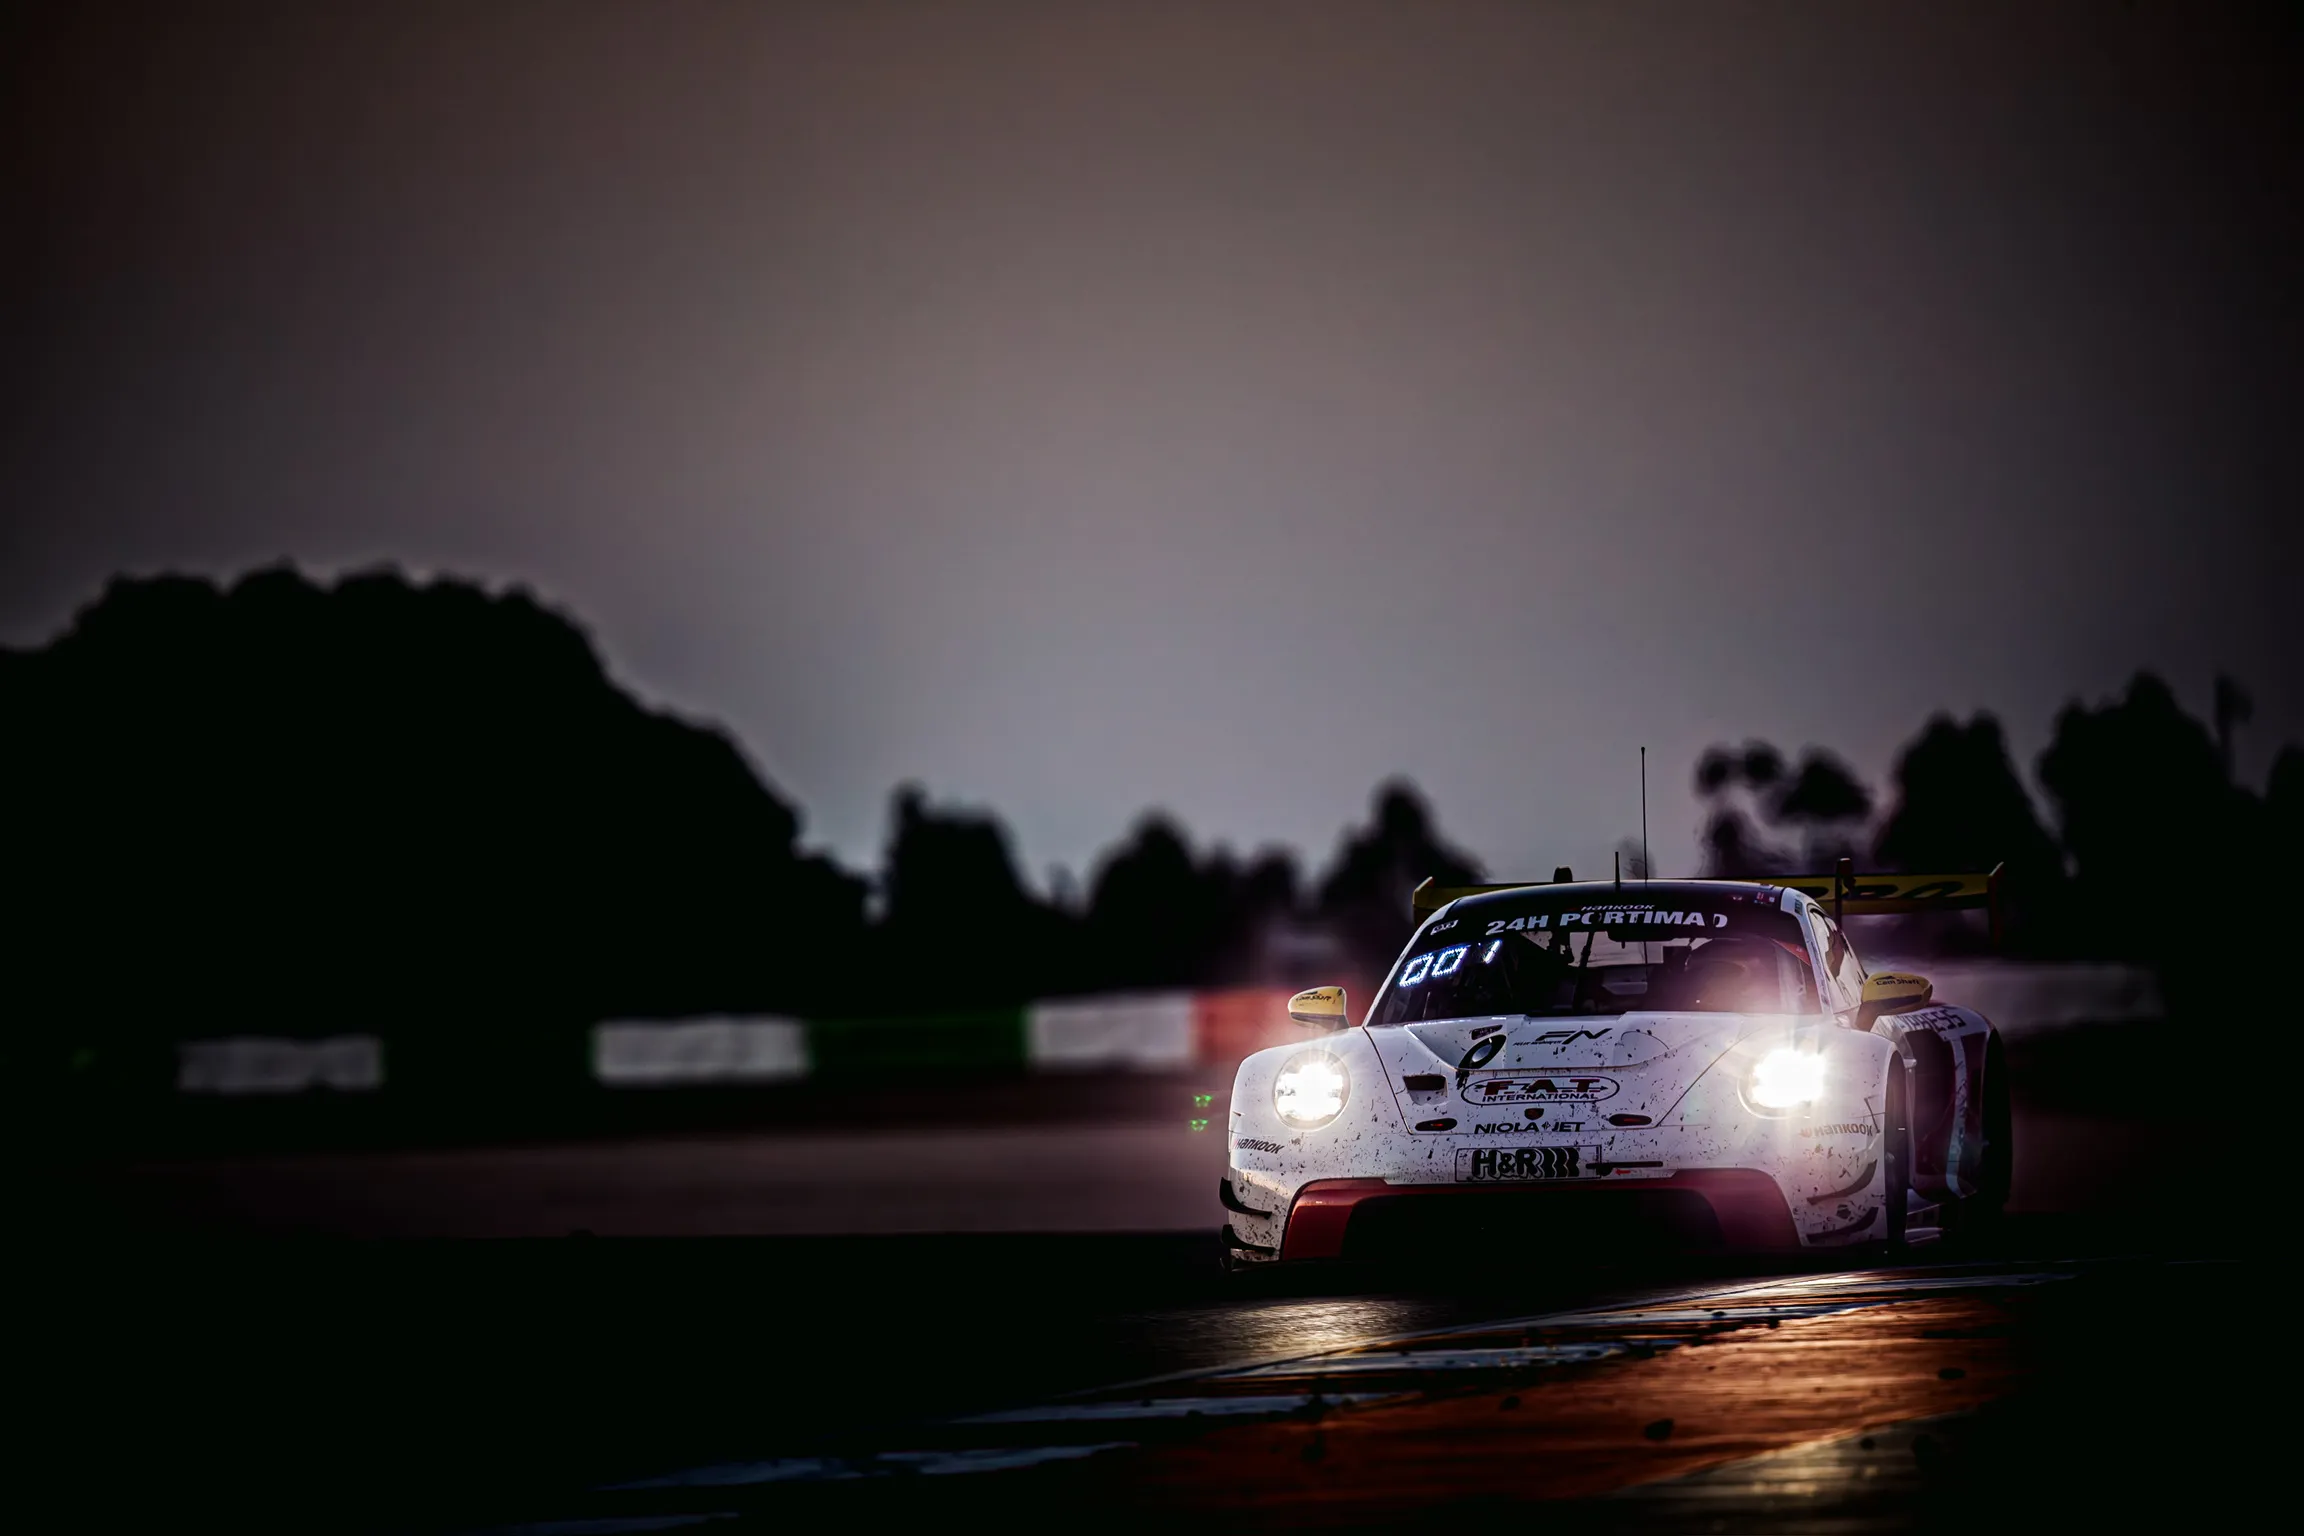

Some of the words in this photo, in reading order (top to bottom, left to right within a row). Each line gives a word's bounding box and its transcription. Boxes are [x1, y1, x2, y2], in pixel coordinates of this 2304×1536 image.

[1485, 914, 1549, 936] 24H
[1482, 1091, 1600, 1103] INTERNATIONAL
[1473, 1122, 1542, 1135] NIOLA
[1551, 1121, 1586, 1133] JET
[1472, 1147, 1546, 1180] H&R
